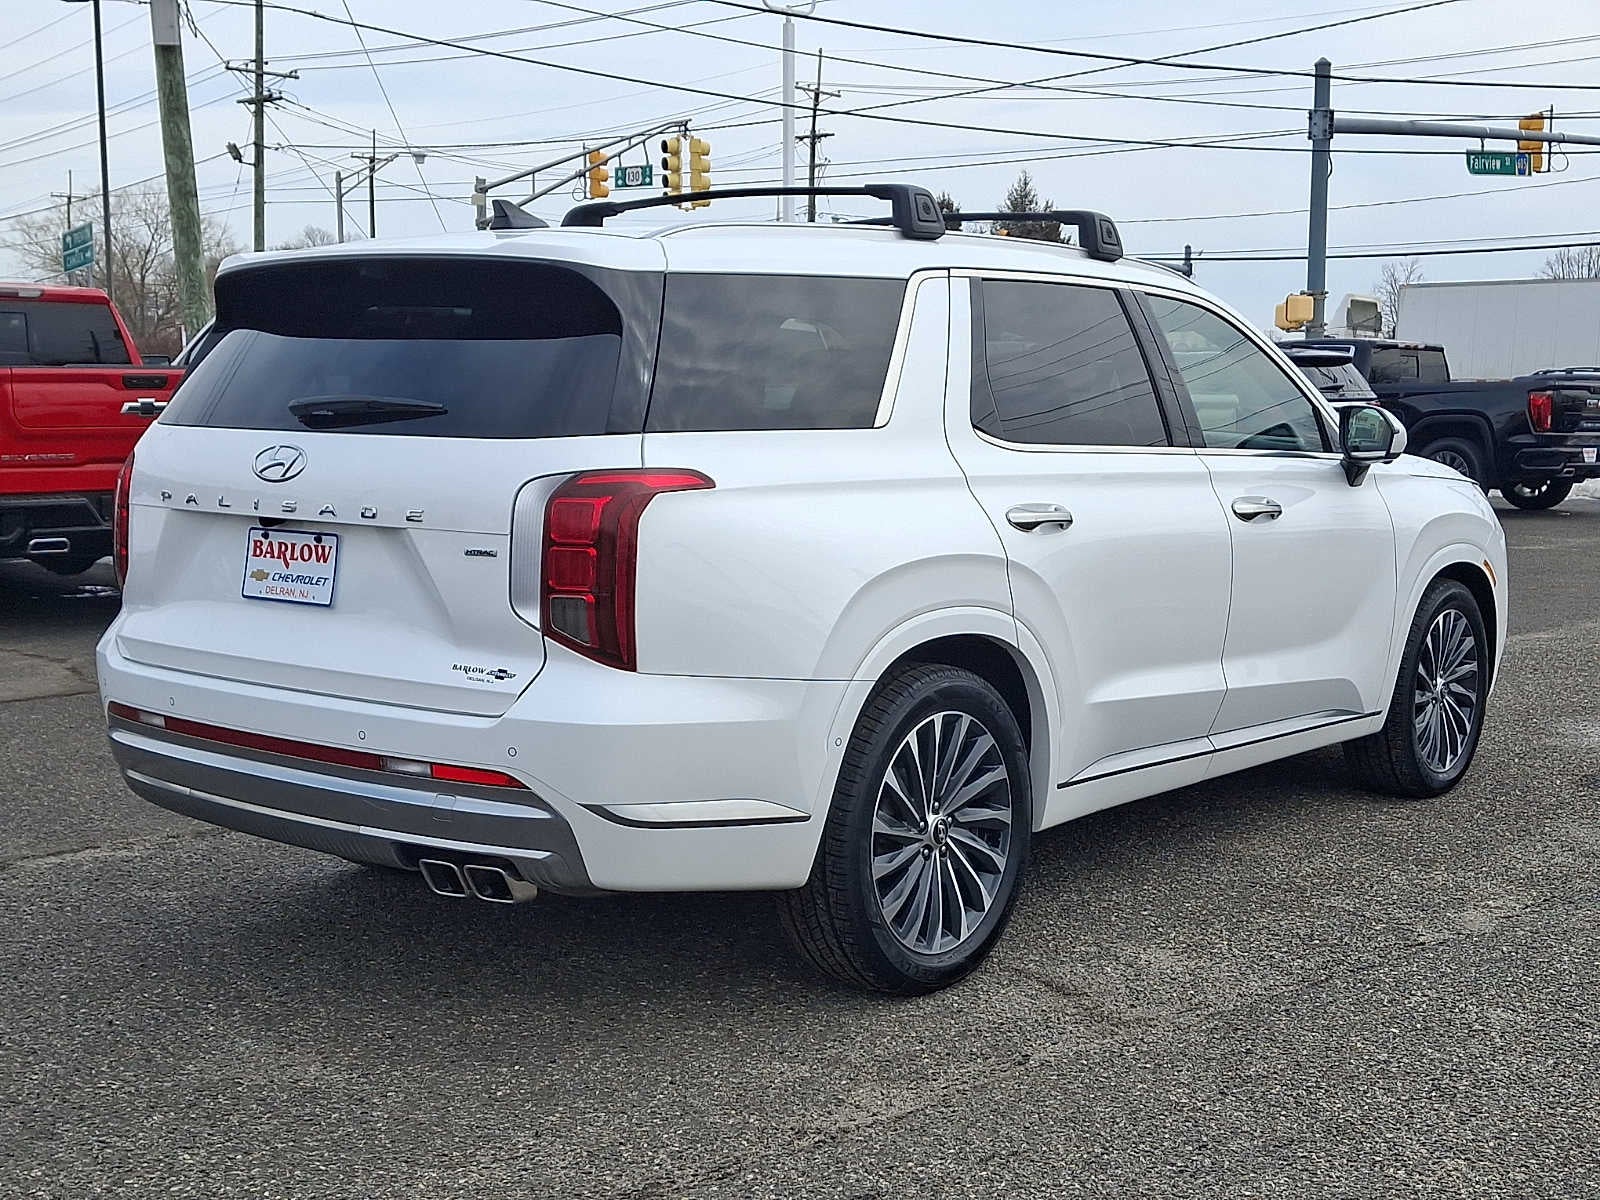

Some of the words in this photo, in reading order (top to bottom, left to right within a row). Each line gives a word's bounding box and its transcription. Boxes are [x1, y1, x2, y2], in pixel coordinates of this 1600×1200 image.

[1470, 155, 1501, 170] Fairview
[628, 170, 640, 182] 130
[160, 489, 424, 523] PALISADE
[252, 539, 333, 570] BARLOW
[271, 572, 329, 587] CHEVROLET
[265, 585, 297, 598] DELRAN,
[299, 588, 309, 598] NJ
[452, 664, 486, 674] BARLOW
